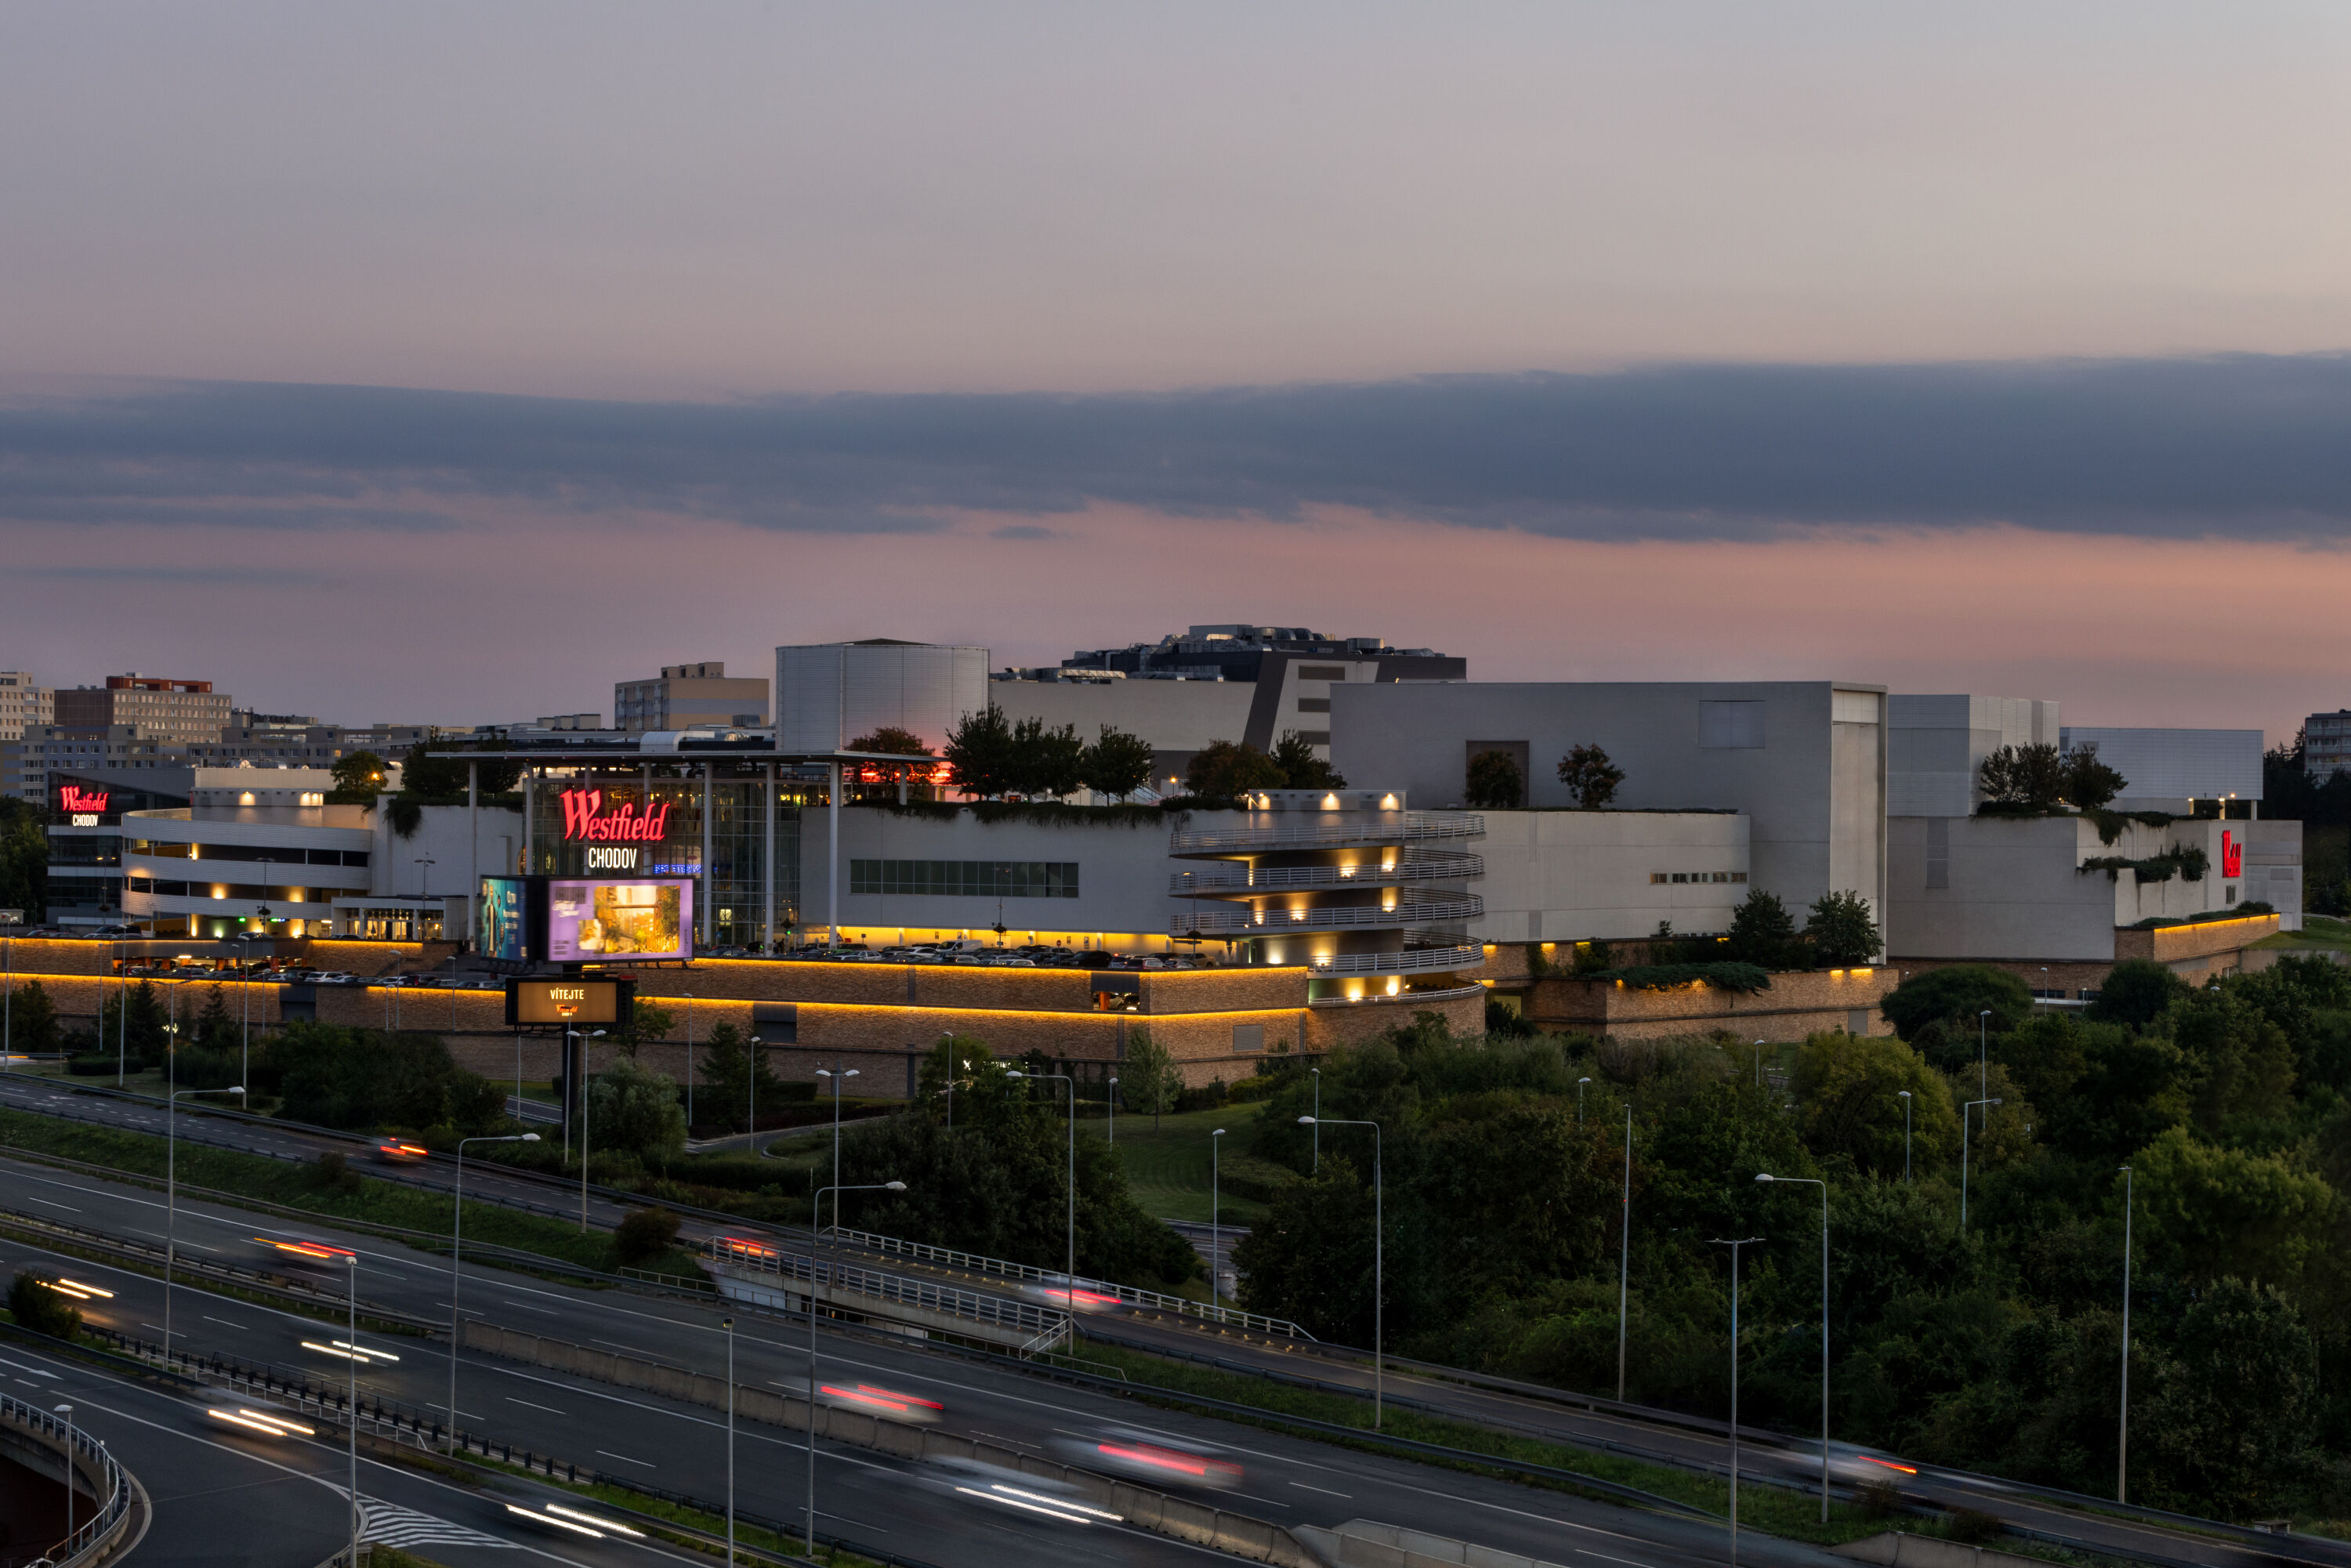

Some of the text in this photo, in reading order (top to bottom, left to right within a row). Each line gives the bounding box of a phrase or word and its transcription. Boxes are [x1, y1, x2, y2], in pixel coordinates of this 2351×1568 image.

[60, 786, 108, 811] Westfield
[72, 814, 99, 827] CHODOV
[560, 789, 671, 841] Westfield
[589, 847, 637, 869] CHODOV
[550, 987, 585, 1000] VÍTEJTE
